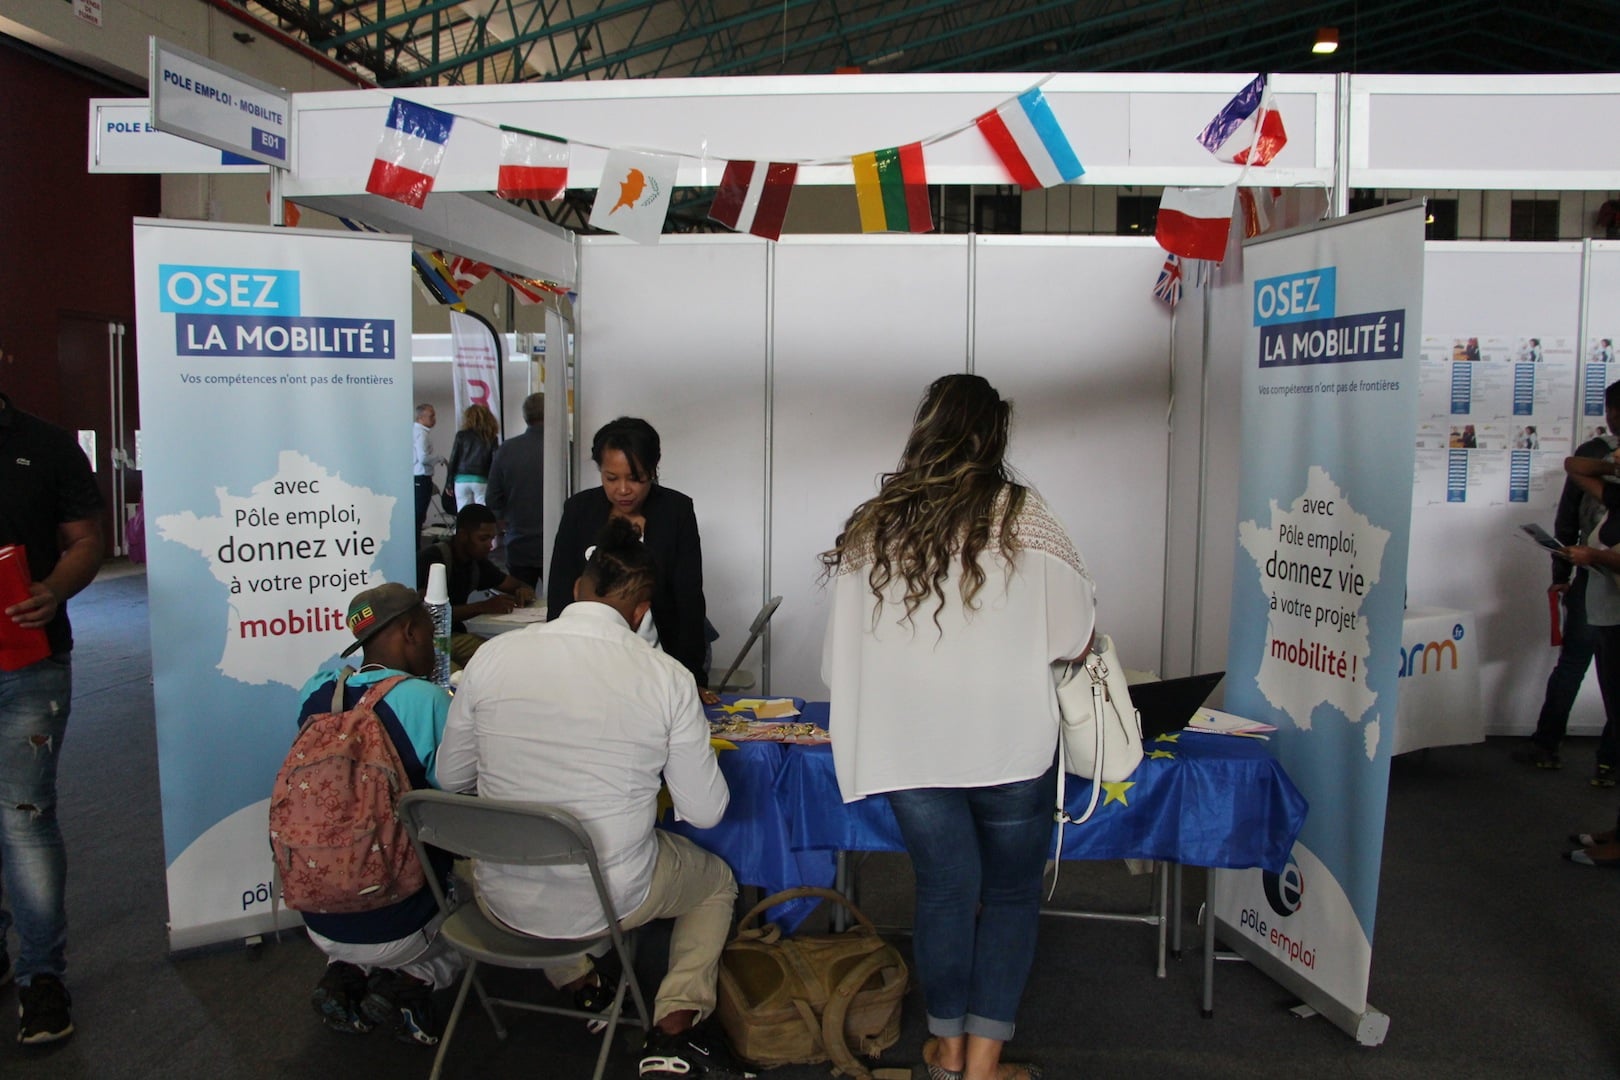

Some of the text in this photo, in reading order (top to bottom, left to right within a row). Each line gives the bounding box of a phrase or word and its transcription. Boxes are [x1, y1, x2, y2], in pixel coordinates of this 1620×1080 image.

[164, 69, 192, 91] POLE
[195, 82, 232, 106] EMPLOI
[240, 100, 283, 125] MOBILITE
[107, 123, 141, 133] POLE
[262, 133, 279, 149] E01
[167, 271, 279, 308] OSEZ
[1257, 276, 1322, 318] OSEZ
[187, 324, 227, 350] LA
[236, 323, 374, 353] MOBILITÉ
[1264, 334, 1287, 361] LA
[1292, 316, 1387, 360] MOBILITÉ
[180, 373, 202, 384] Vos
[204, 373, 277, 387] compétences
[310, 376, 328, 387] pas
[331, 374, 343, 384] de
[346, 374, 394, 385] frontières
[1258, 385, 1270, 395] Vos
[1270, 383, 1313, 397] compétences
[1336, 384, 1348, 395] pas
[1349, 380, 1358, 392] de
[1359, 379, 1400, 392] frontières
[274, 480, 320, 495] avec
[235, 504, 361, 529] Pôle emploi,
[1302, 499, 1335, 516] avec
[218, 530, 375, 564] donnez vie
[1279, 524, 1357, 558] Pôle emploi,
[230, 568, 369, 595] à votre projet
[1265, 550, 1364, 596] donnez vie
[240, 607, 351, 639] mobilit
[1270, 592, 1356, 633] à votre projet
[1271, 638, 1348, 679] mobilité
[242, 881, 284, 911] pôl
[1240, 908, 1316, 970] pôle emploi
